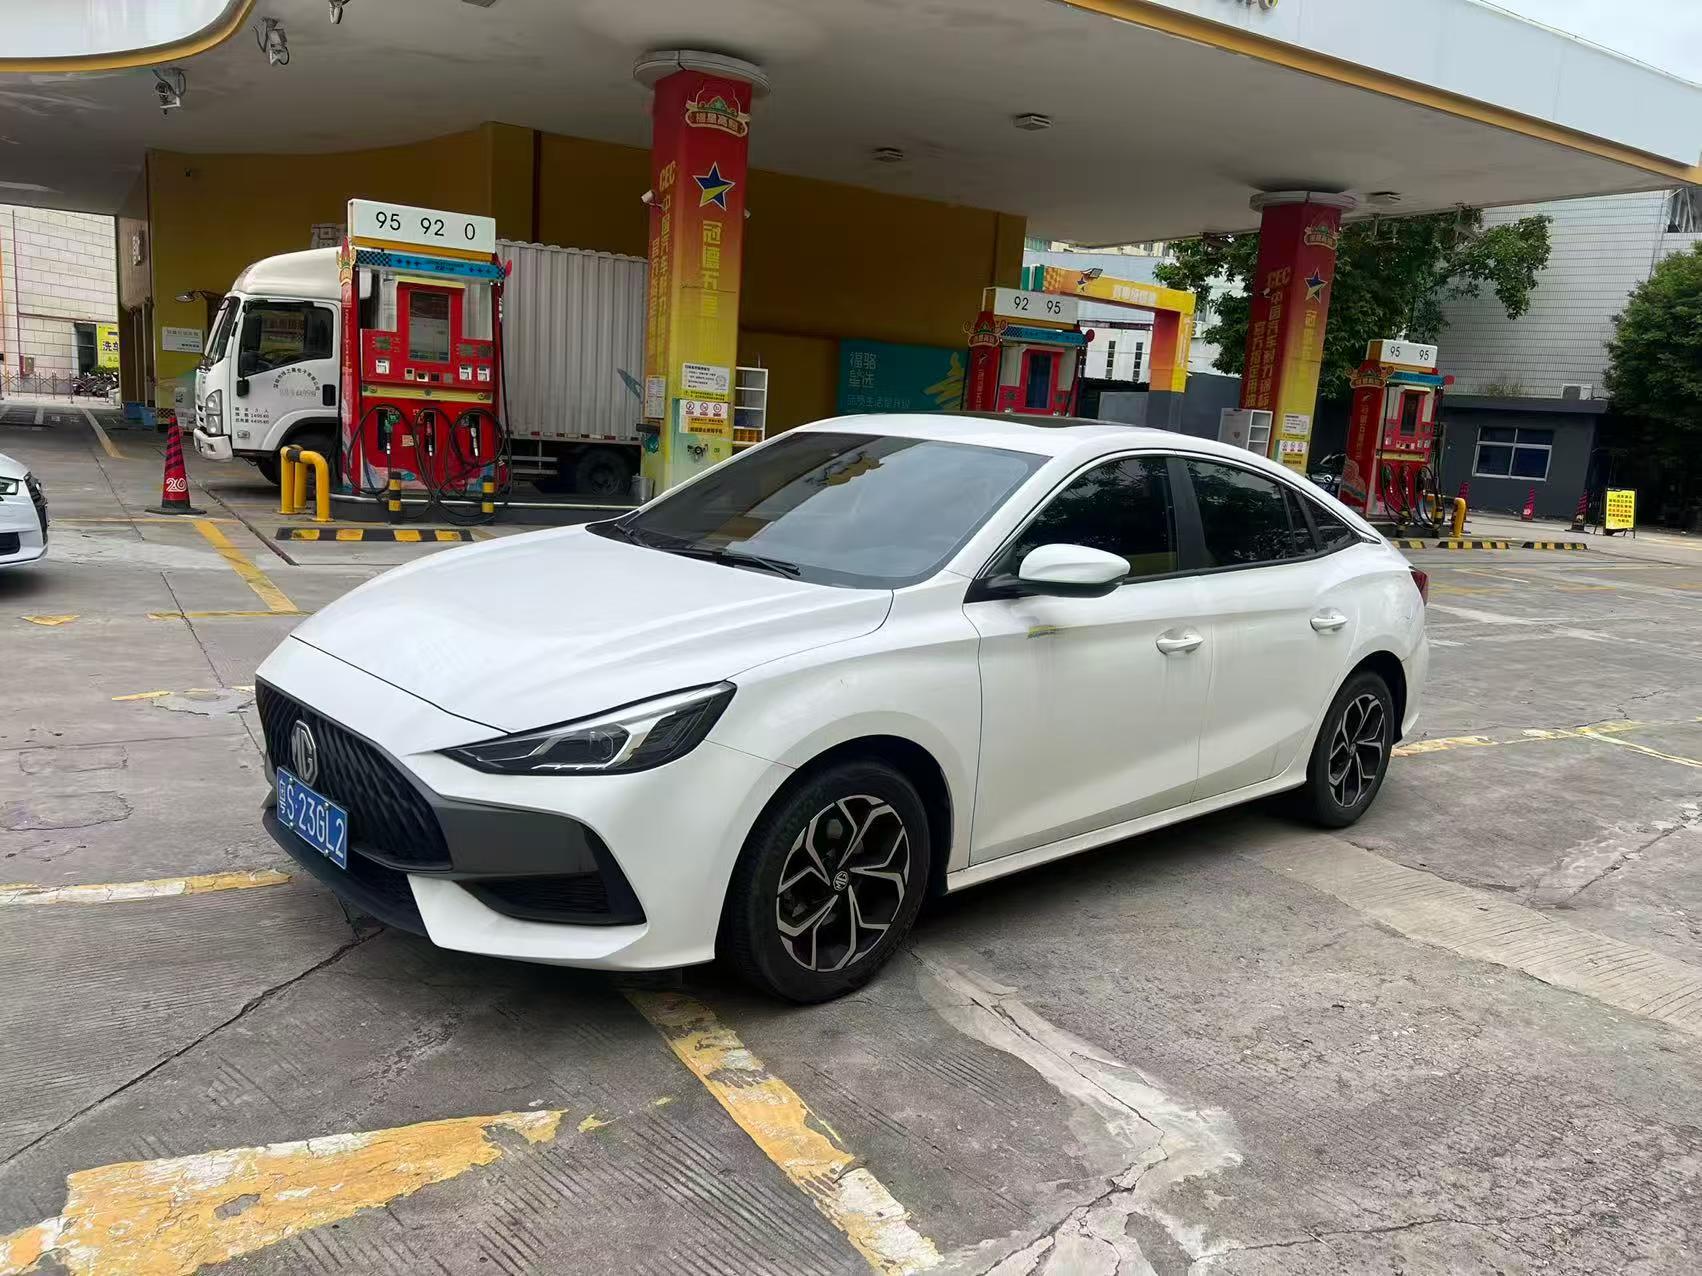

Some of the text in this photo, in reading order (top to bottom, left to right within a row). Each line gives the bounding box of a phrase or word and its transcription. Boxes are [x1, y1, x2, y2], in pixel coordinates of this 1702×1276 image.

[375, 211, 476, 240] 95 92 0
[1014, 296, 1061, 315] 92 95
[1390, 346, 1430, 361] 95 95
[291, 723, 315, 783] MG
